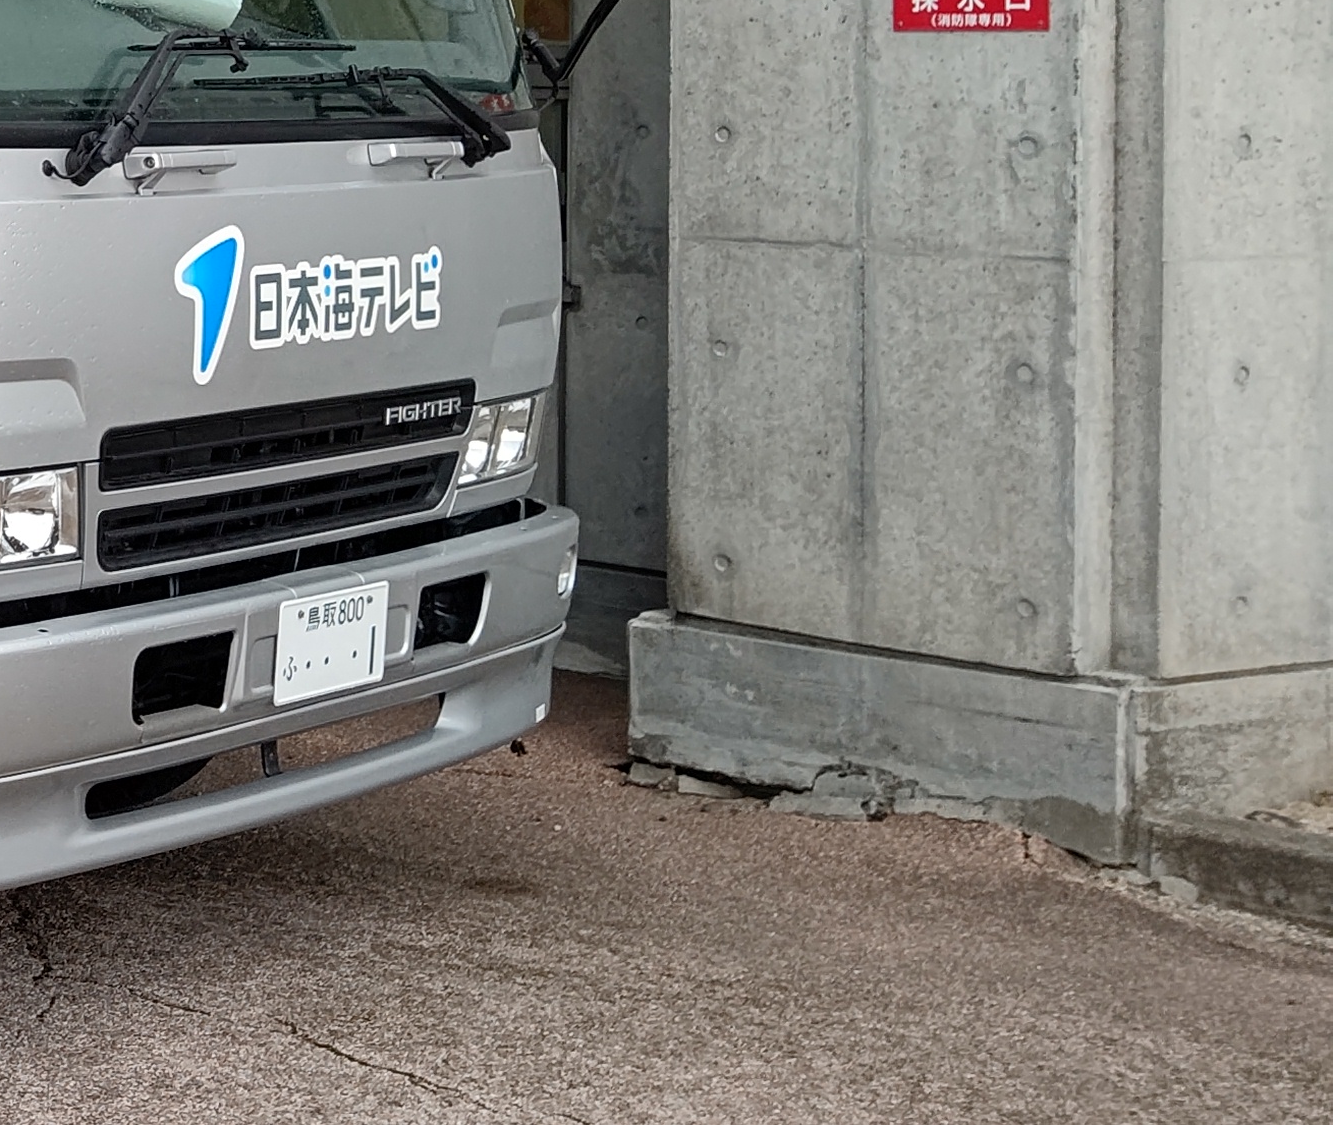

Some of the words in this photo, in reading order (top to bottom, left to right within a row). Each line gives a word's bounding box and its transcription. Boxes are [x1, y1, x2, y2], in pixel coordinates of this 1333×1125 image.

[253, 251, 439, 343] 日本海テレビ
[385, 396, 462, 426] FIGHTER
